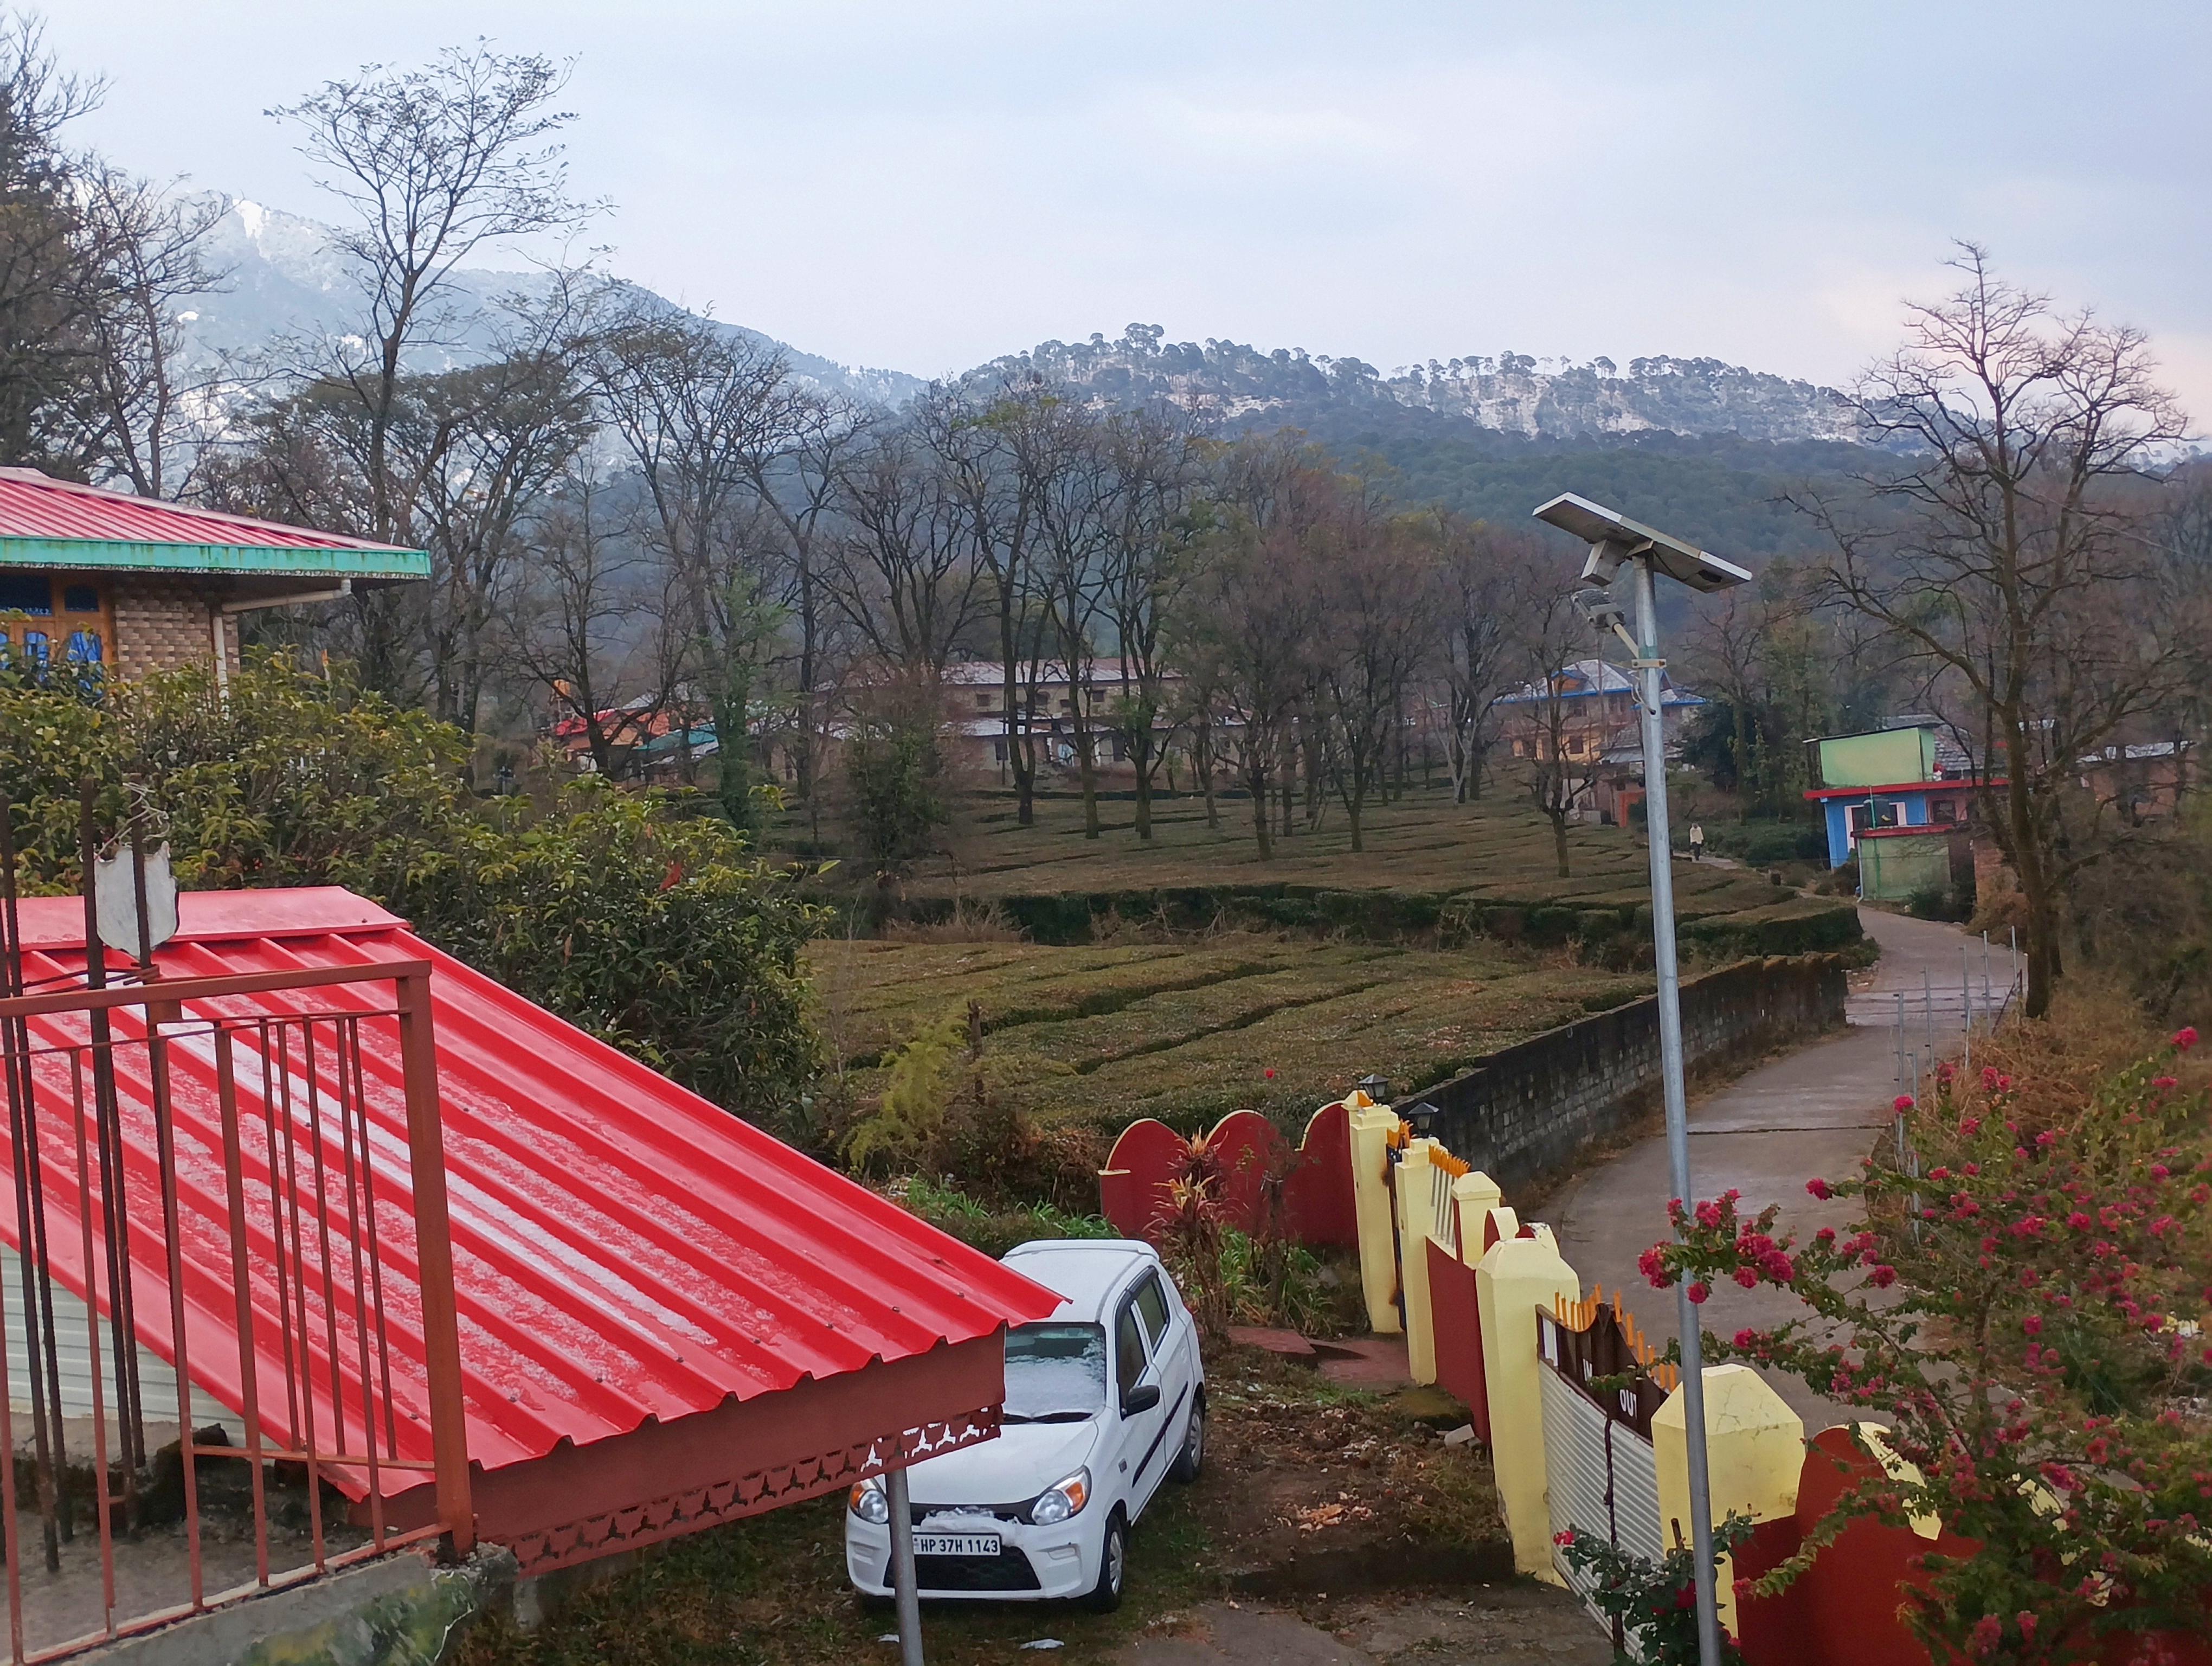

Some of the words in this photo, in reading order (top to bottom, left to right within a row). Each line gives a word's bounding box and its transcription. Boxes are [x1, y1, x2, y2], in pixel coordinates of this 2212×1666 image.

[921, 1539, 936, 1552] HP
[939, 1539, 963, 1553] 37H
[968, 1539, 998, 1553] 1143
